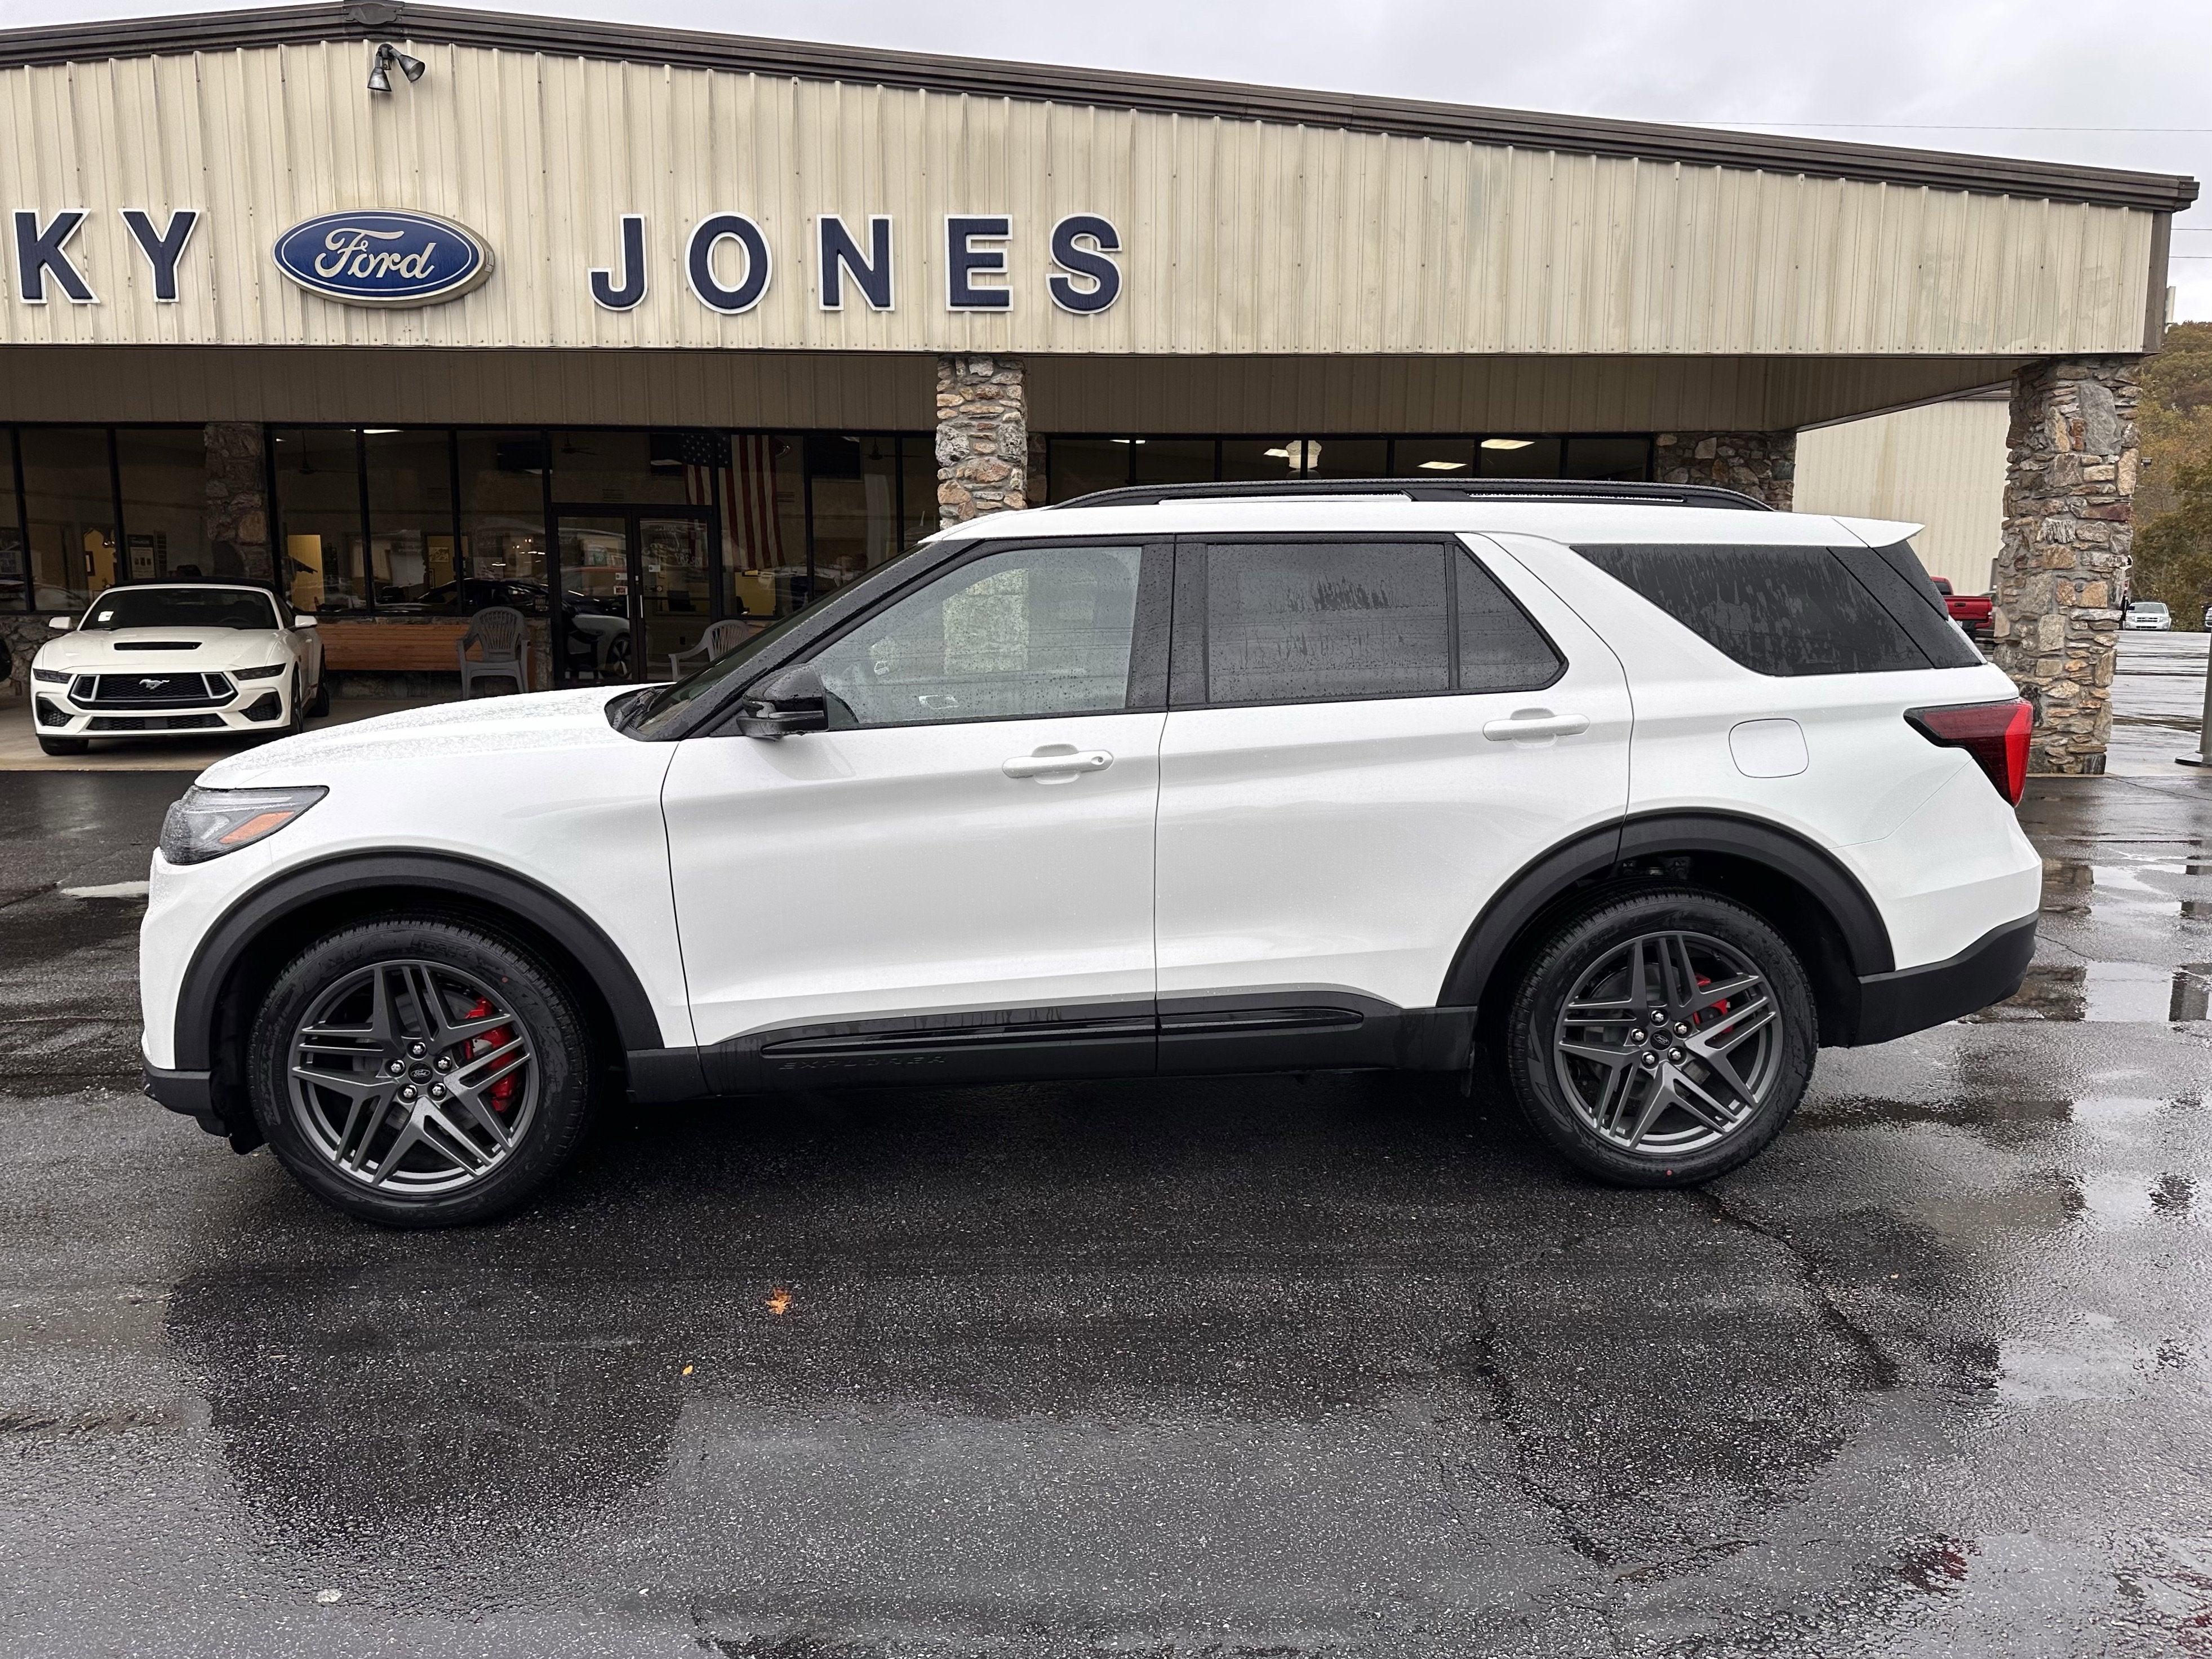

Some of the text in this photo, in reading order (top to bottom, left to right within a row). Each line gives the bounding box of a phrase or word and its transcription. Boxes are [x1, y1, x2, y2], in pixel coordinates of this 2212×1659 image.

[12, 208, 1123, 314] KY JONES
[314, 228, 437, 278] Ford
